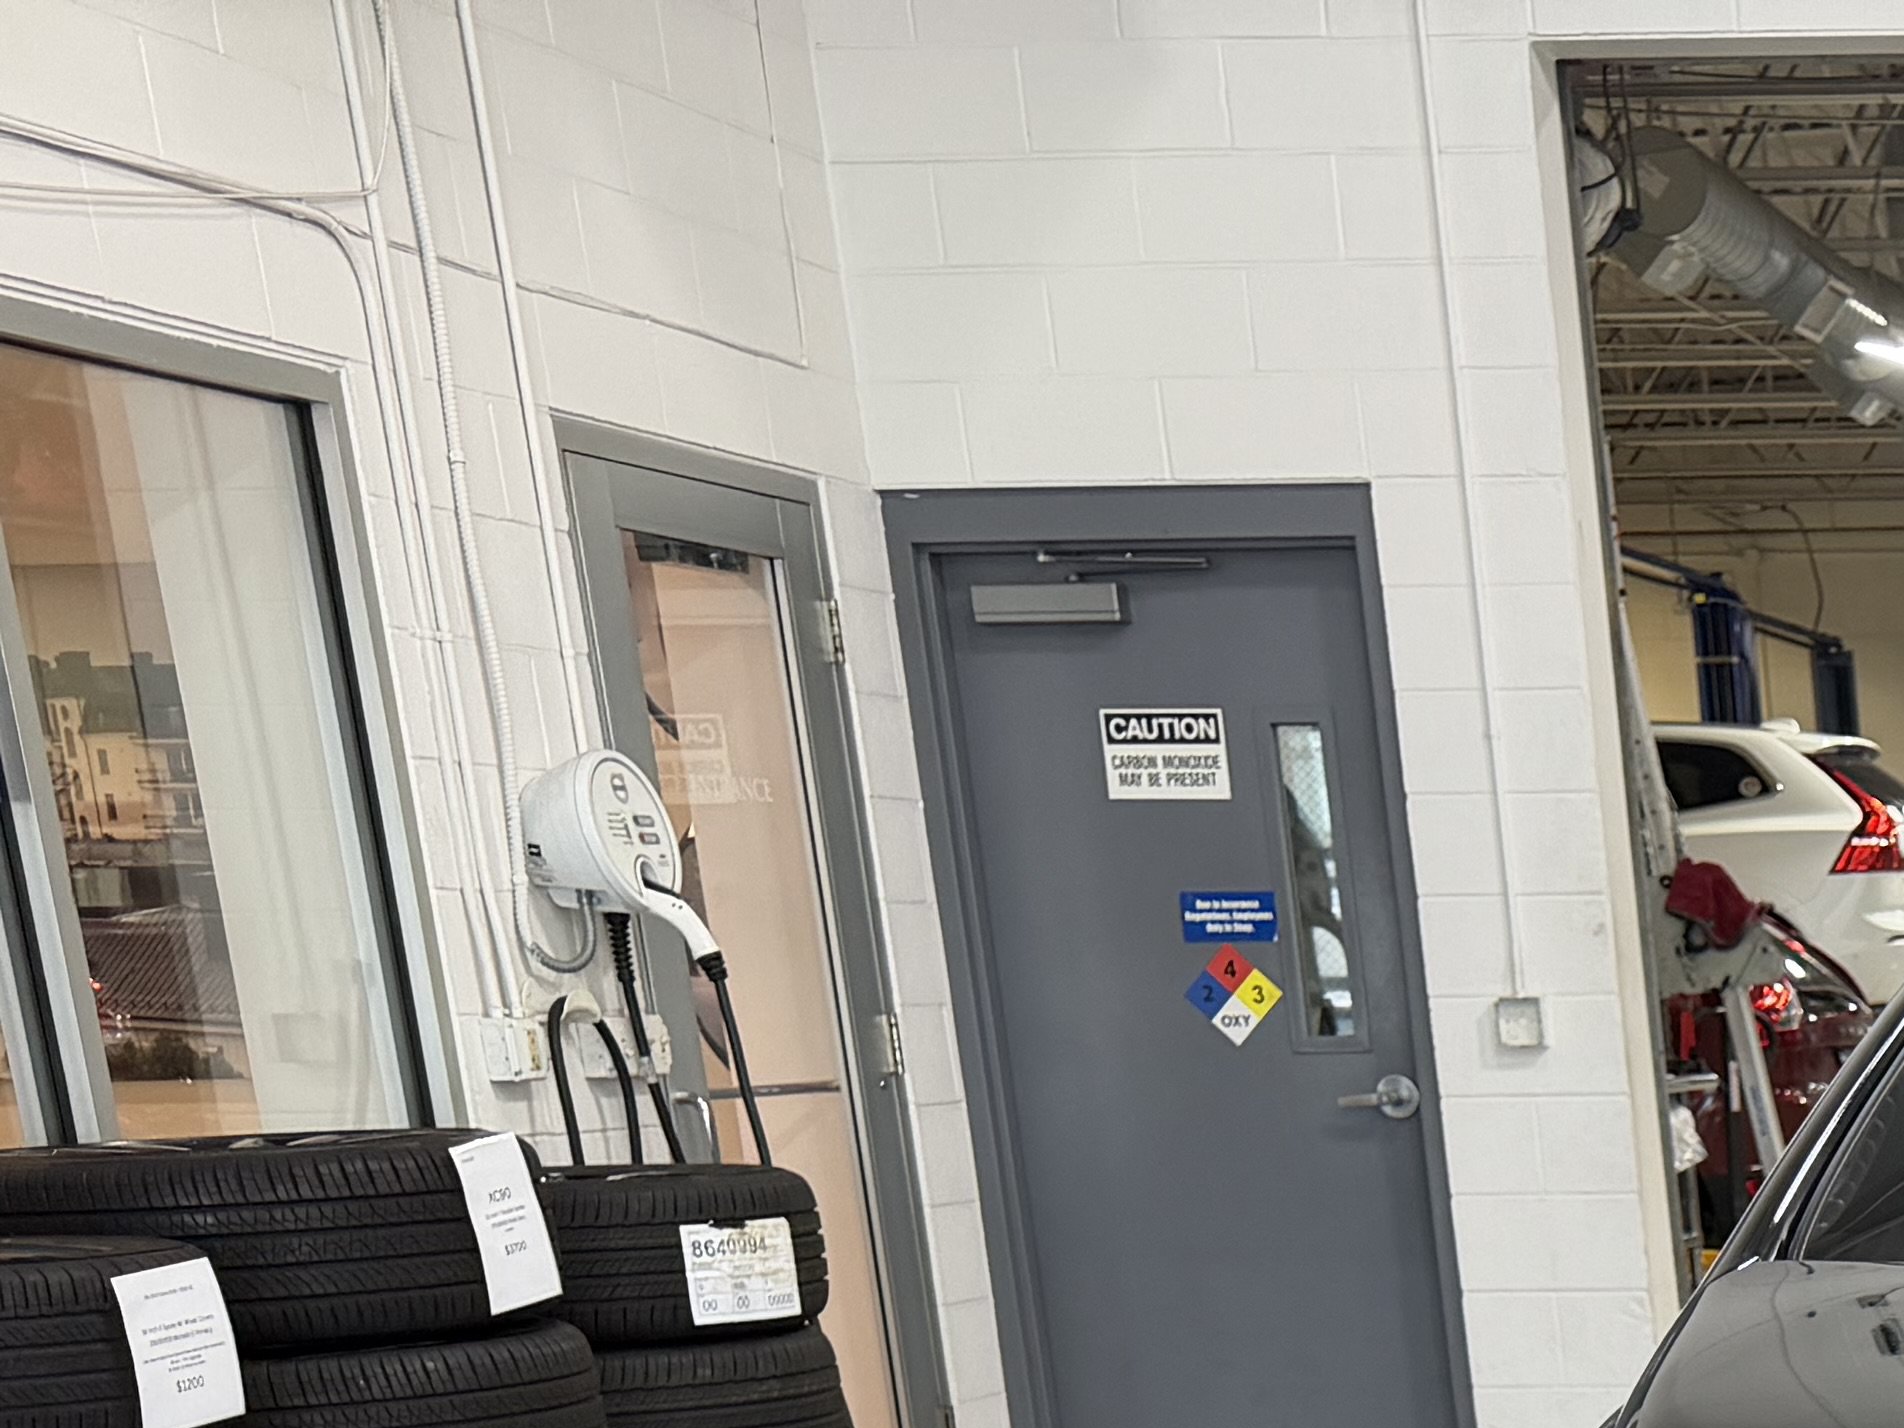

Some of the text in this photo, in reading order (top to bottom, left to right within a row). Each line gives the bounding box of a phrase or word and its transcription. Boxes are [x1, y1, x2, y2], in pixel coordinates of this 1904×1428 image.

[1109, 717, 1217, 741] CAUTION
[1111, 754, 1222, 770] CARBON MONOXIDE
[1118, 772, 1217, 787] MAY BE PRESENT
[1223, 959, 1237, 978] 4
[1202, 984, 1265, 1004] 2 3
[1220, 1014, 1251, 1028] OXY
[175, 1375, 205, 1394] $1200
